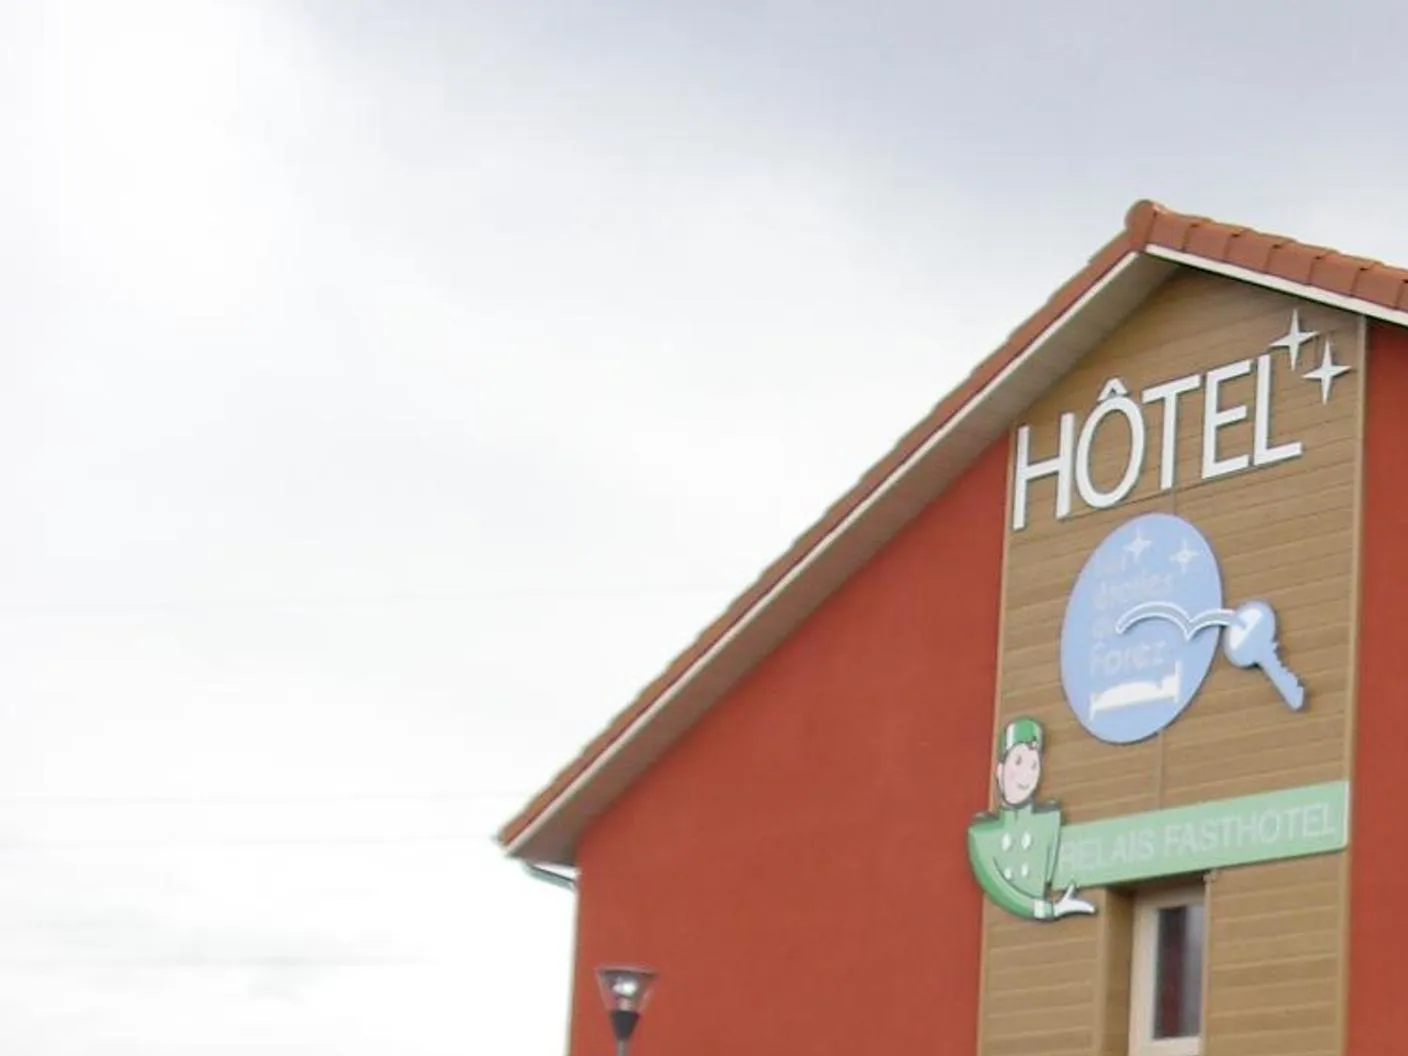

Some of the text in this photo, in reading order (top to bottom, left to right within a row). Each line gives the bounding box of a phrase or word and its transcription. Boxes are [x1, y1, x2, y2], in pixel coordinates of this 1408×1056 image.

[1012, 354, 1302, 531] HÔTEL
[1060, 803, 1336, 874] RELAIS FASTHOTEL
